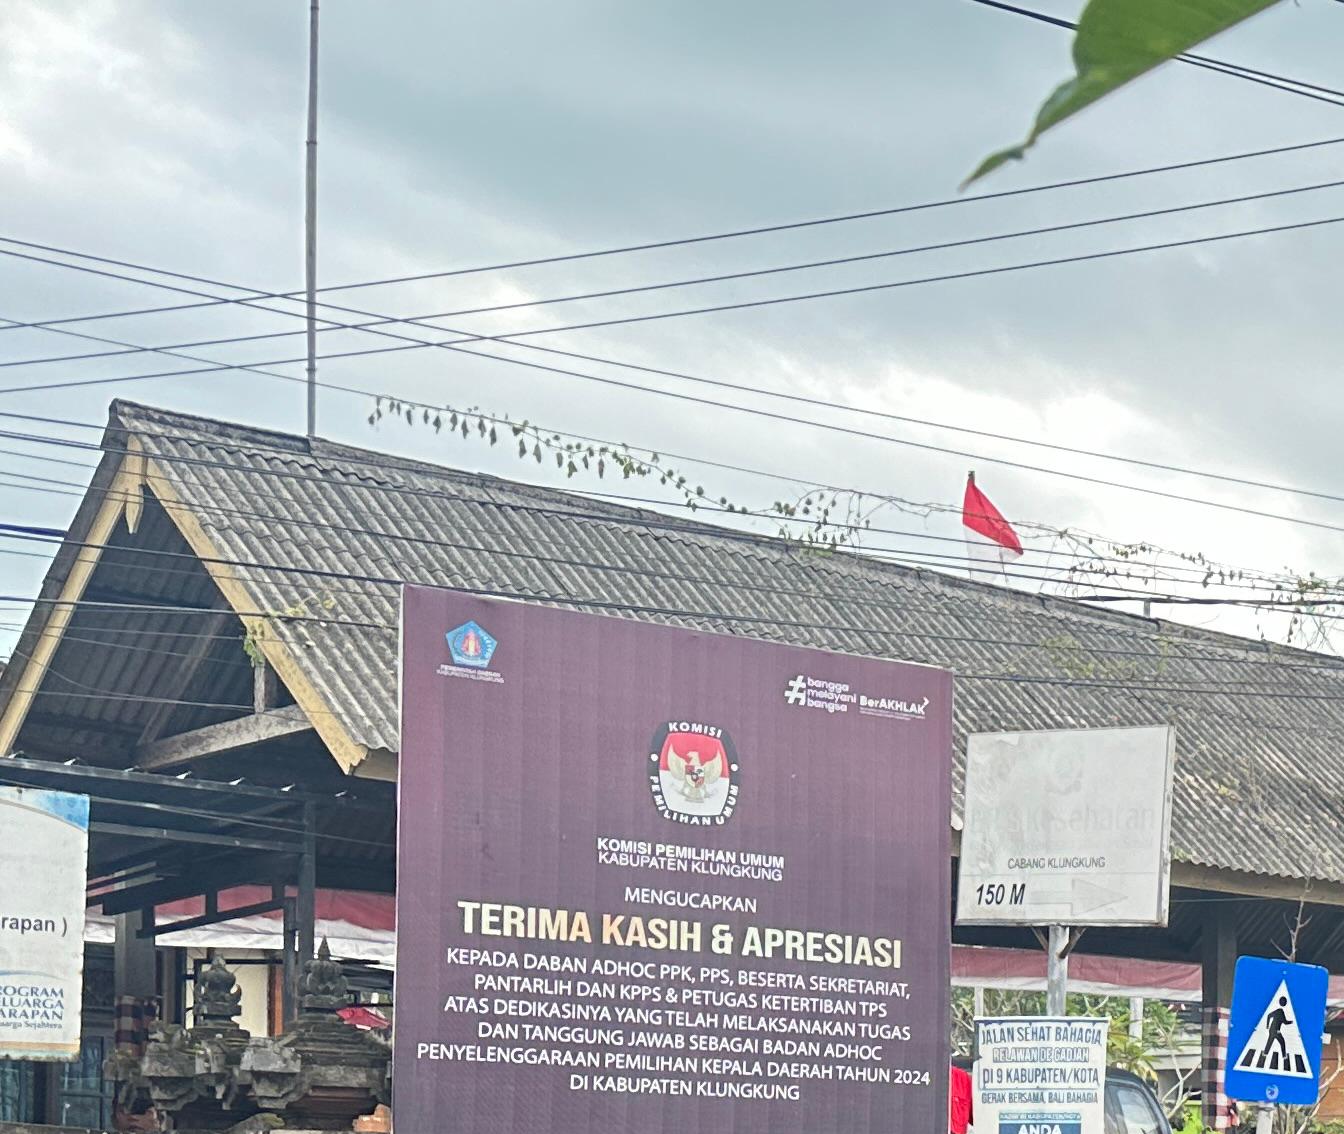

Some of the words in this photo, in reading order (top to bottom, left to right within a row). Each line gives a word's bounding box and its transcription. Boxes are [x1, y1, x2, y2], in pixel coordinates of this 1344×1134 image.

[807, 677, 849, 693] bangga
[807, 688, 857, 703] melayani
[807, 698, 848, 713] bangsa
[859, 695, 928, 715] BerAKHLAK
[668, 722, 722, 738] KOMISI
[650, 776, 711, 825] PEMILIHAN
[716, 784, 739, 825] UMUM
[597, 837, 651, 855] KOMISI
[655, 843, 736, 864] PEMILIHAN
[740, 852, 784, 869] UMUM
[1007, 857, 1047, 870] CABANG
[1048, 856, 1106, 869] KLUNGKUNG
[598, 851, 688, 872] KABUPATEN
[691, 862, 782, 881] KLUNGKUNG
[624, 886, 757, 913] MENGUCAPKAN
[975, 883, 1005, 905] 150
[1009, 883, 1026, 905] M
[1, 916, 55, 935] rapan
[457, 900, 592, 943] TERIMA
[602, 913, 701, 953] KASIH
[711, 924, 734, 955] &
[741, 926, 902, 968] APRESIASI
[447, 948, 519, 969] KEPADA
[523, 953, 586, 973] DABAN
[591, 959, 656, 979] ADHOC
[660, 964, 696, 984] PPK,
[700, 967, 734, 987] PPS,
[738, 971, 805, 990] BESERTA
[809, 976, 911, 999] SEKRETARIAT,
[0, 997, 64, 1010] LUARGA
[474, 974, 572, 996] PANTARLIH
[576, 981, 615, 999] DAN
[620, 985, 661, 1003] KPPS
[665, 988, 678, 1003] &
[682, 989, 757, 1009] PETUGAS
[762, 995, 856, 1015] KETERTIBAN
[859, 1001, 887, 1018] TPS
[444, 996, 489, 1014] ATAS
[494, 999, 611, 1021] DEDIKASINYA
[614, 1007, 662, 1025] YANG
[665, 1009, 718, 1028] TELAH
[722, 1014, 856, 1037] MELAKSANAKAN
[858, 1022, 911, 1041] TUGAS
[478, 1022, 518, 1039] DAN
[522, 1024, 623, 1045] TANGGUNG
[628, 1030, 684, 1049] JAWAB
[689, 1034, 758, 1054] SEBAGAI
[763, 1039, 820, 1057] BADAN
[823, 1043, 882, 1061] ADHOC
[981, 1028, 1015, 1045] JALAN
[1016, 1026, 1052, 1042] SEHAT
[1055, 1026, 1102, 1045] BAHAGIA
[417, 1043, 600, 1067] PENYELENGGARAAN
[604, 1053, 698, 1073] PEMILIHAN
[702, 1058, 762, 1077] KEPALA
[767, 1061, 833, 1080] DAERAH
[836, 1065, 890, 1083] TAHUN
[893, 1069, 930, 1086] 2024
[983, 1068, 994, 1084] DI
[996, 1068, 1003, 1083] 9
[1006, 1068, 1099, 1084] KABUPATEN/KOTA
[570, 1074, 588, 1090] DI
[593, 1076, 692, 1095] KABUPATEN
[697, 1081, 800, 1101] KLUNGKUNG
